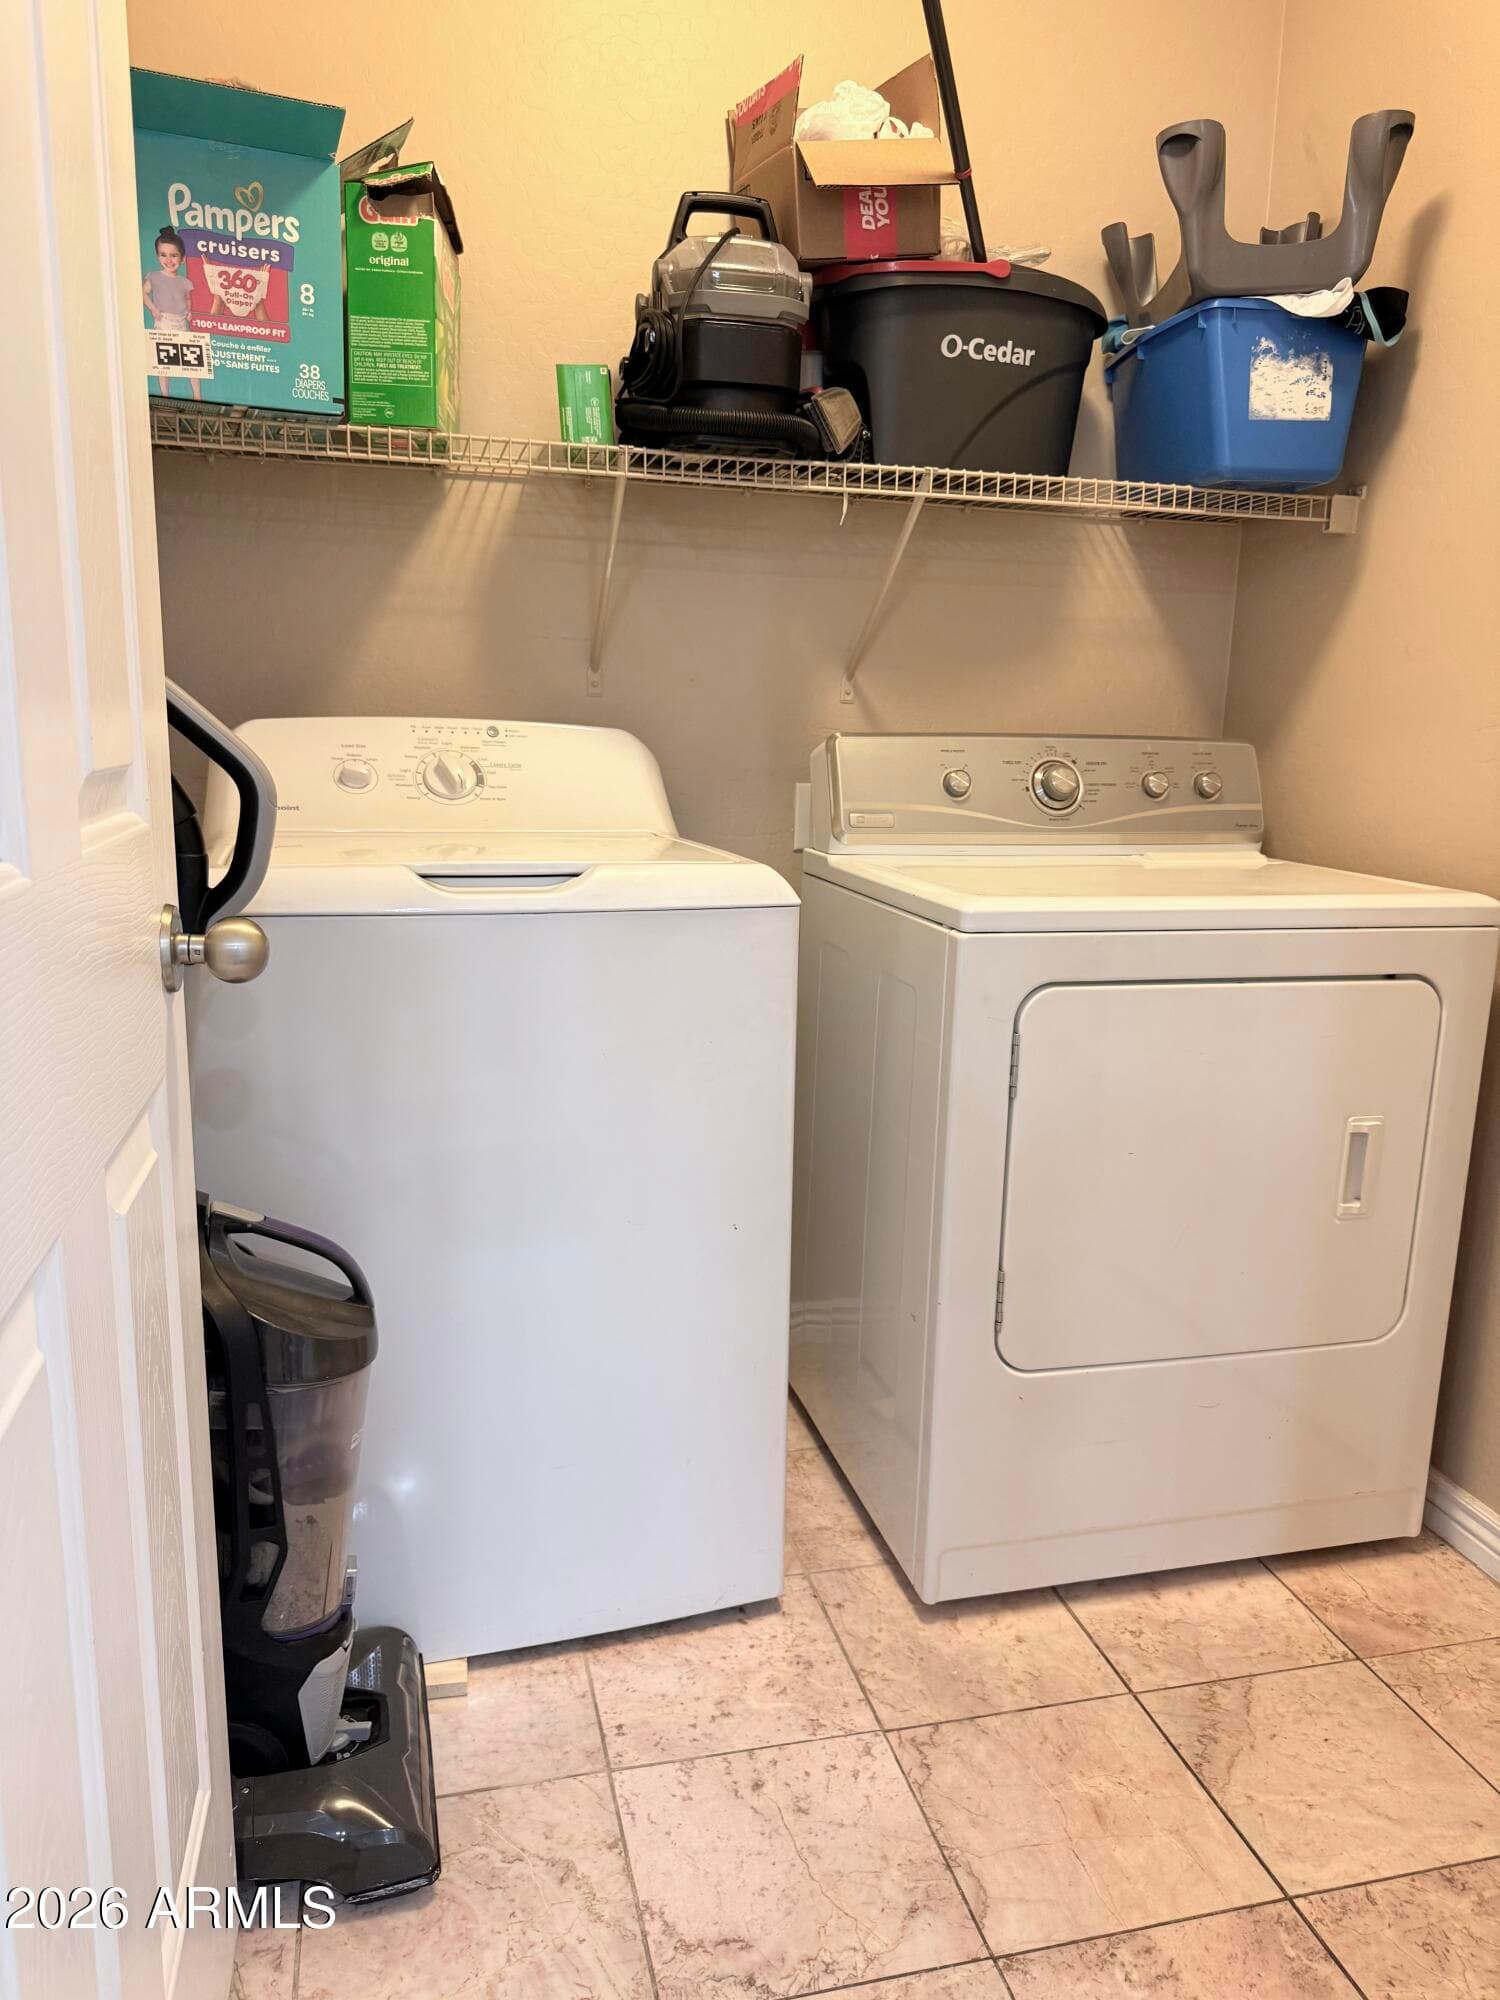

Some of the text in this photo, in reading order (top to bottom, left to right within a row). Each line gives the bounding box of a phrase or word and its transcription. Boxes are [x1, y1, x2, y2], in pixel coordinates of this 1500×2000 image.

[168, 183, 300, 243] Pampers
[859, 187, 876, 230] DEA
[197, 240, 280, 262] cruisers
[369, 256, 409, 267] original
[225, 290, 254, 300] Pull-On
[300, 283, 315, 305] 8
[226, 298, 253, 307] Diaper
[218, 322, 271, 336] LEAKPROOF
[272, 329, 286, 337] FIT
[211, 340, 239, 349] Couche
[247, 344, 271, 353] enfiler
[941, 334, 1036, 366] O-Cedar
[226, 361, 249, 370] SANS
[251, 363, 280, 373] FUITES
[299, 363, 321, 380] 38
[295, 378, 326, 391] DIAPERS
[292, 387, 330, 401] COUCHES
